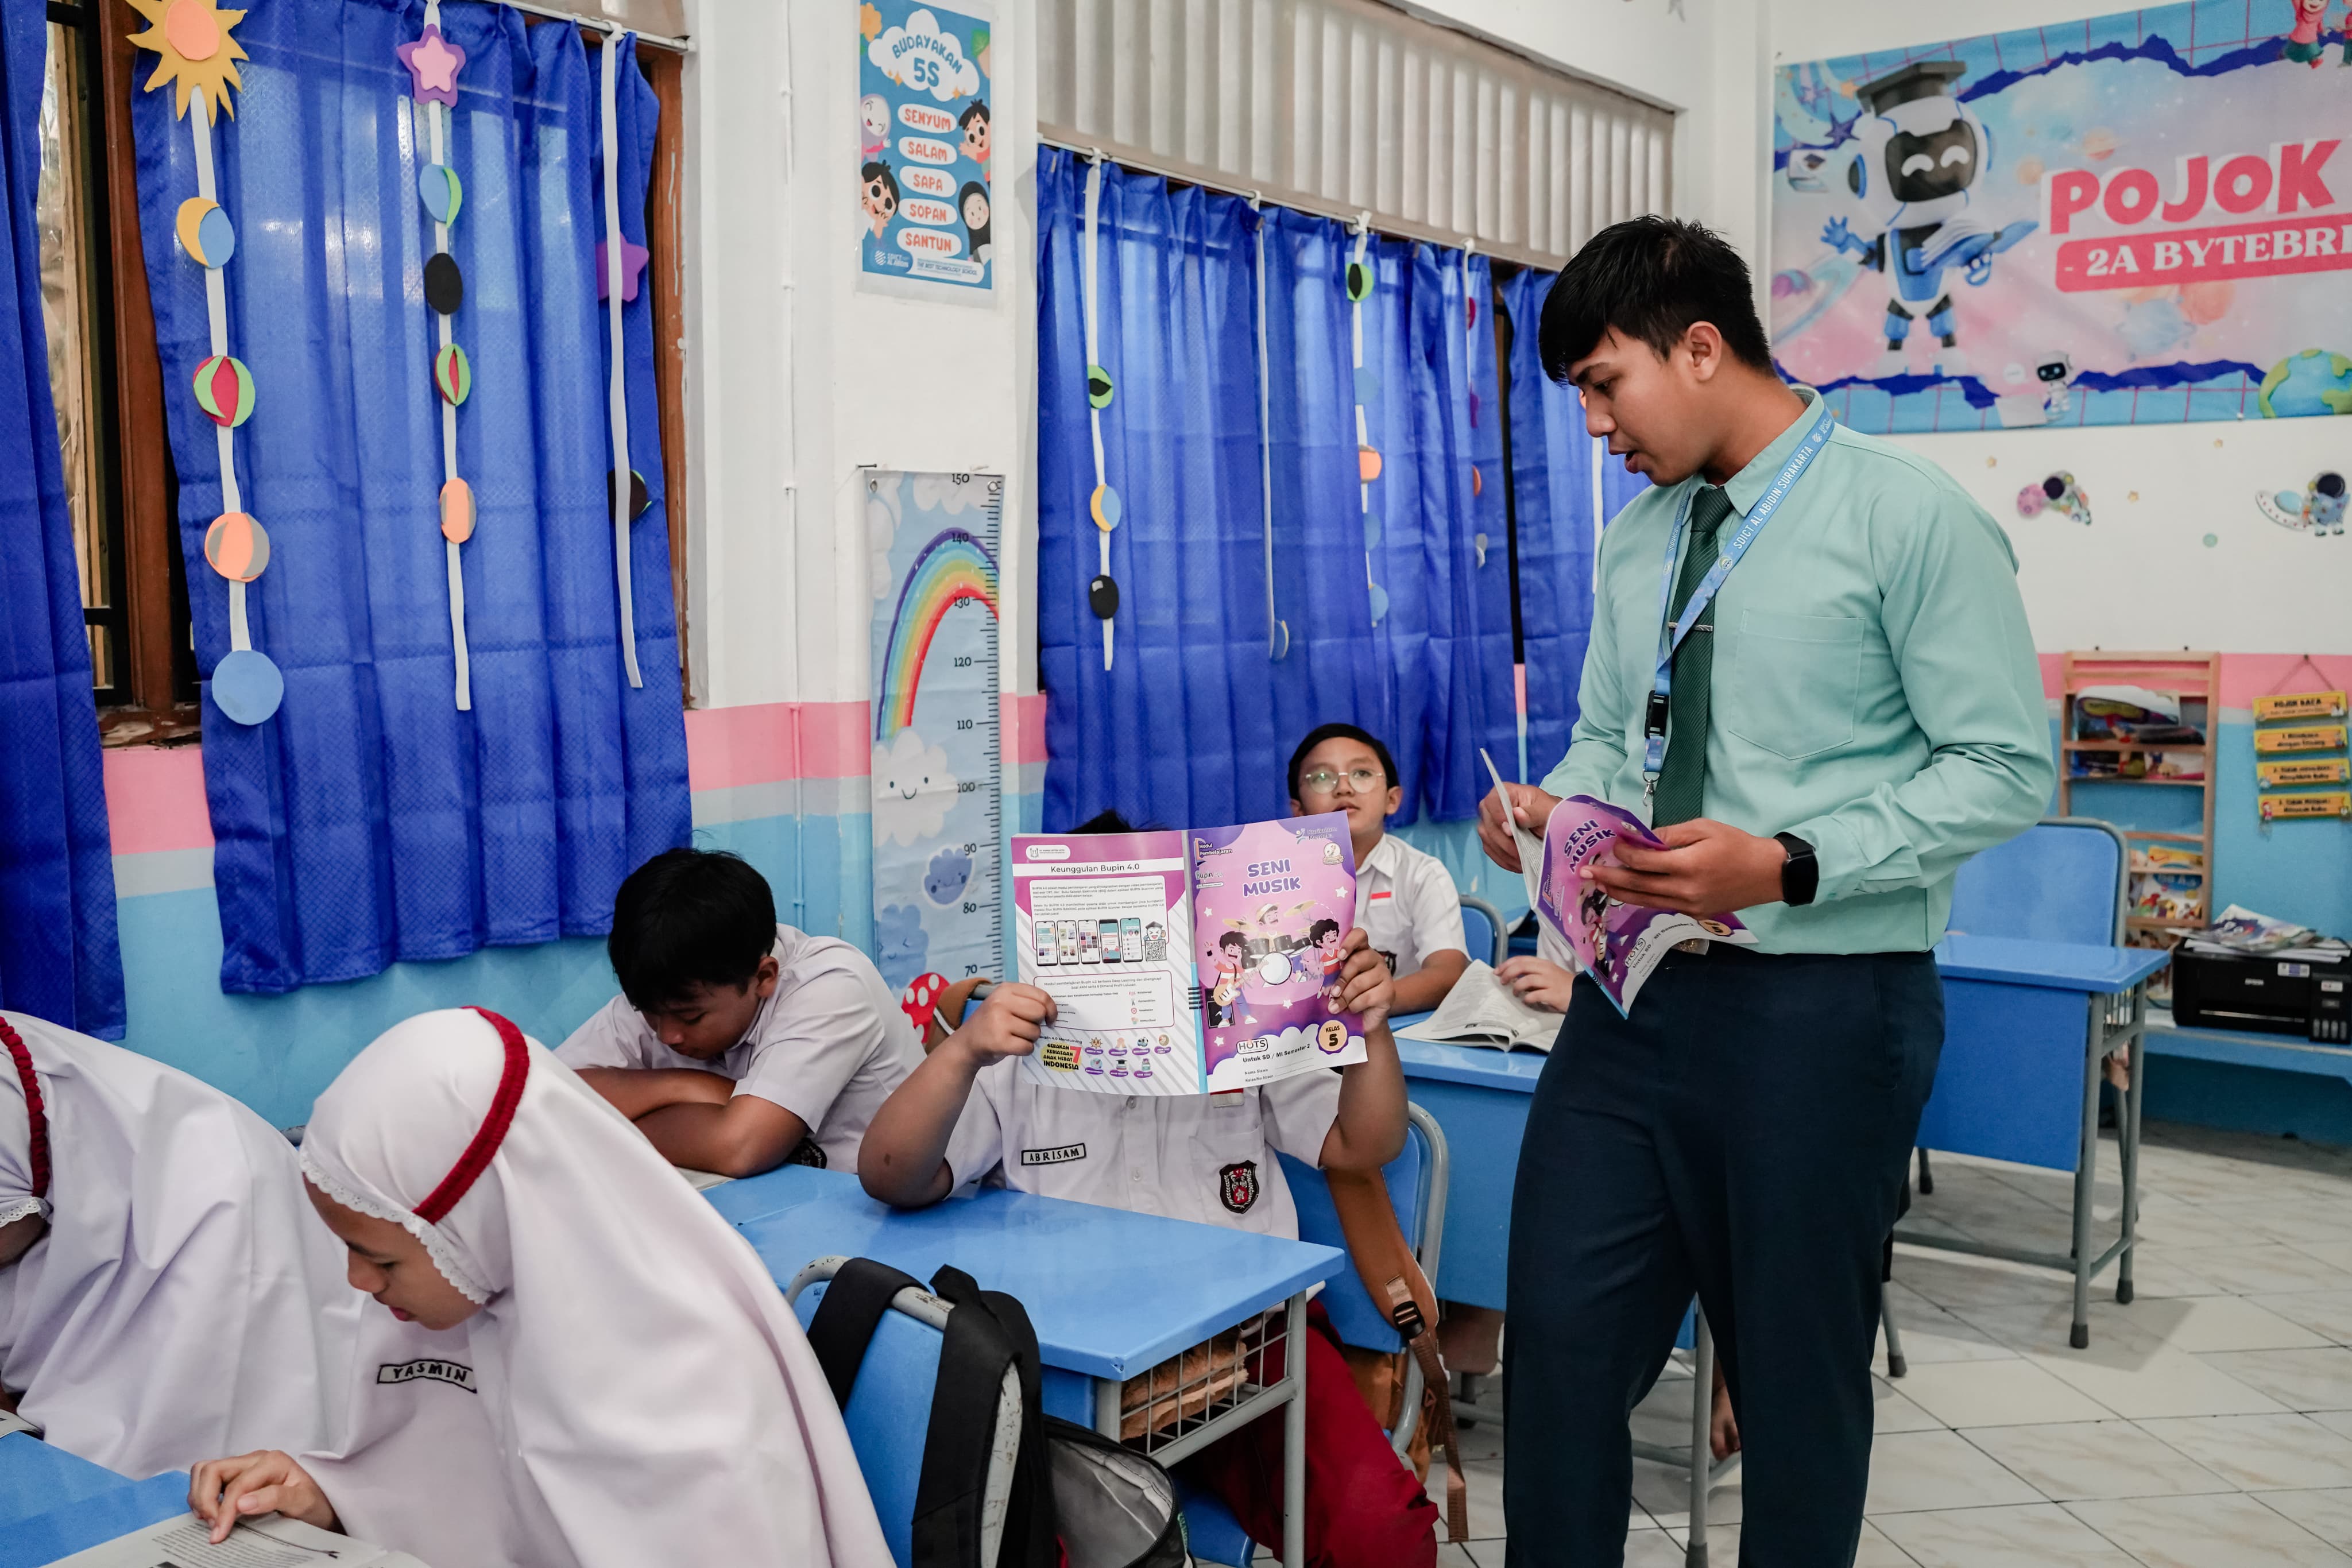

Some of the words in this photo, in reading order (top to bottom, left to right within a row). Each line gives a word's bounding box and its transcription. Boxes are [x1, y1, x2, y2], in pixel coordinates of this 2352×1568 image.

[892, 34, 962, 74] BUDAYAKAN
[914, 57, 940, 87] 5S
[904, 109, 951, 131] SENYUM
[908, 142, 948, 161] SALAM
[914, 174, 943, 191] SAPA
[2048, 138, 2342, 235] POJOK
[910, 203, 947, 222] SOPAN
[905, 233, 951, 252] SANTUN
[2087, 245, 2140, 277] 2A
[952, 474, 970, 486] 150
[1733, 524, 1754, 549] SDICT
[1750, 515, 1764, 526] AL
[1758, 487, 1783, 516] ABIDIN
[1777, 446, 1814, 489] SURAKARTA
[952, 533, 969, 544] 140
[954, 597, 970, 609] 130
[954, 657, 972, 667] 120
[957, 720, 973, 730] 110
[958, 782, 976, 793] 100
[1564, 820, 1599, 857] SENI
[964, 844, 977, 855] 90
[1569, 829, 1616, 872] MUSIK
[1051, 865, 1098, 874] Keunggulan
[1101, 864, 1124, 872] Bupin
[1127, 862, 1140, 870] 4.0
[1247, 858, 1291, 878] SENI
[1243, 876, 1302, 898] MUSIK
[963, 903, 976, 913] 80
[1624, 939, 1644, 965] HOTS
[965, 965, 978, 977] 70
[1325, 1025, 1340, 1033] KELAS
[1239, 1040, 1266, 1050] HOTS
[1329, 1033, 1339, 1047] 5
[1046, 1048, 1073, 1056] KEBIASAAN
[1070, 1046, 1082, 1064] 7
[1284, 1045, 1306, 1056] Semester
[1043, 1060, 1079, 1071] INDONESIA
[1030, 1148, 1080, 1162] ABRISAM
[393, 1362, 467, 1383] YASMIN
